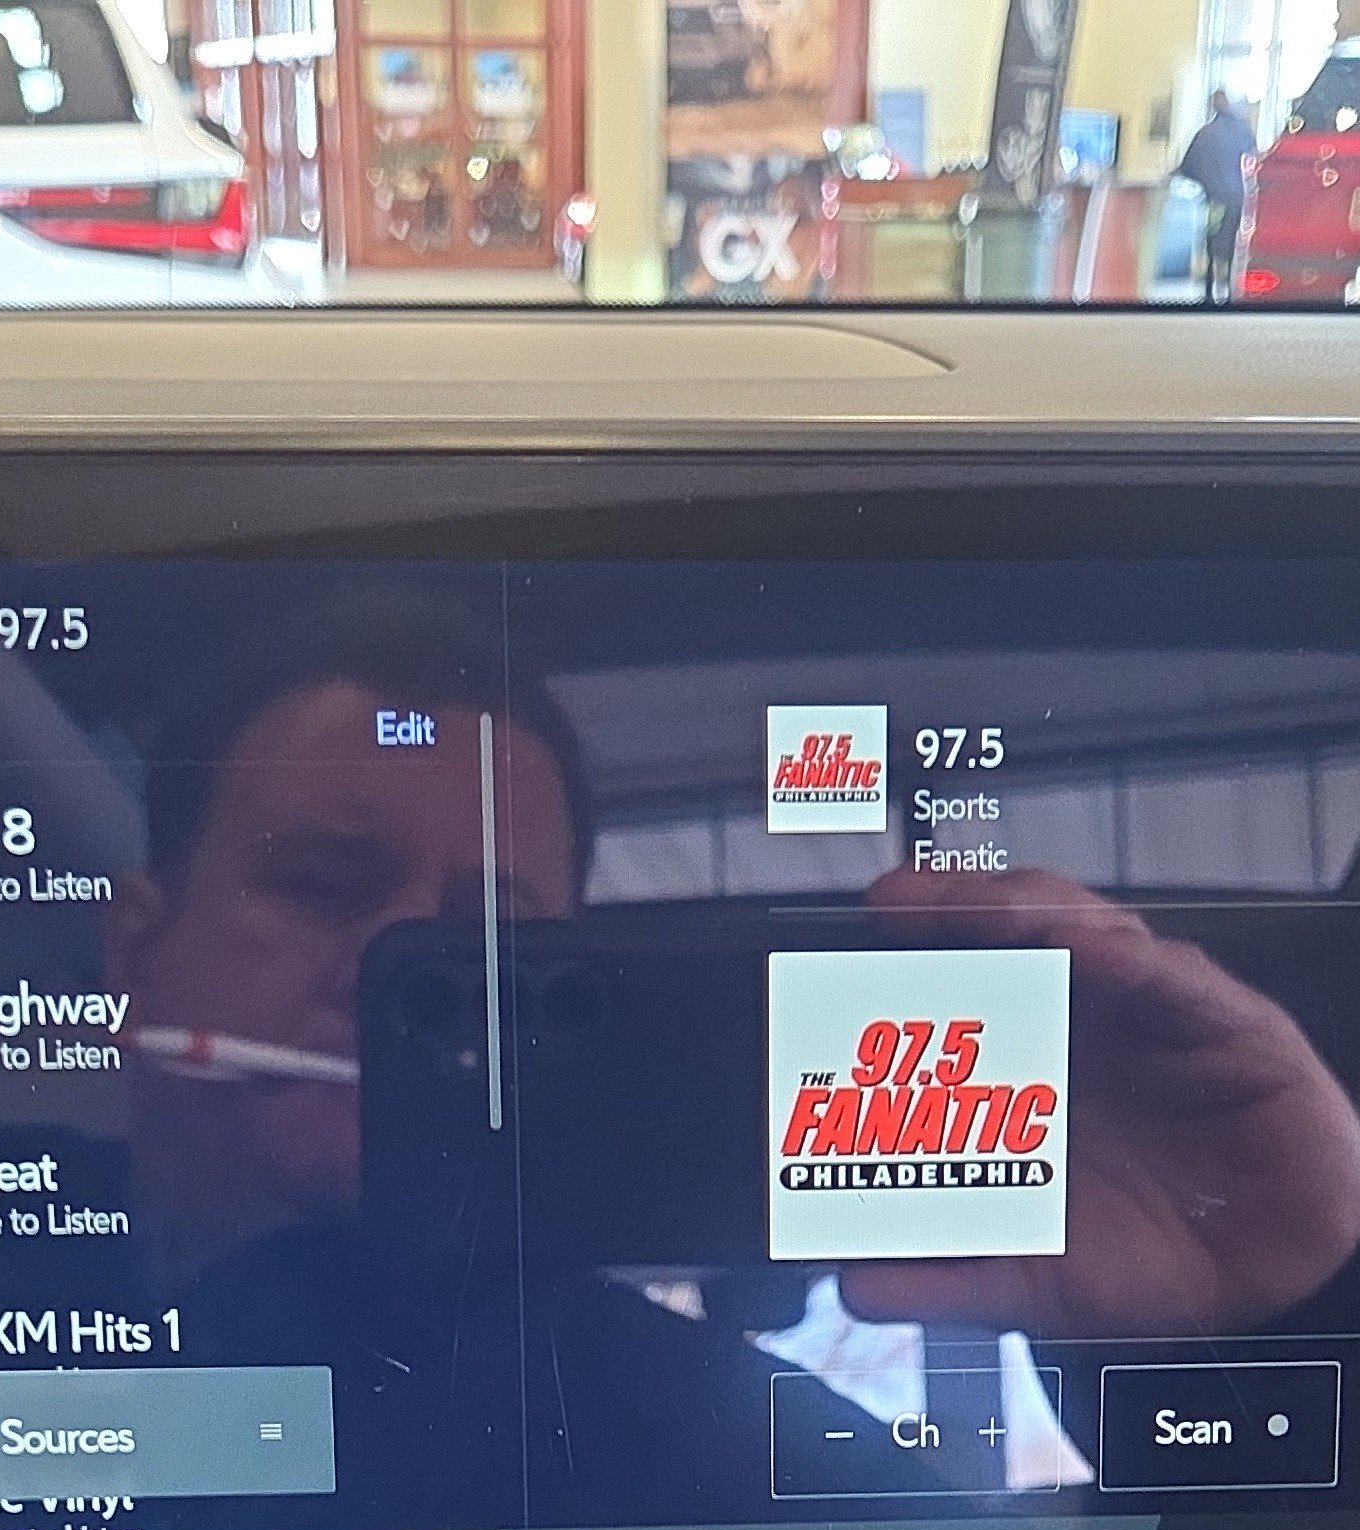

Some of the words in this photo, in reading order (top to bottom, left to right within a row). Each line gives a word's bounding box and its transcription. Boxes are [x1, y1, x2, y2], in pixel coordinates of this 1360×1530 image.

[699, 213, 801, 283] GX
[375, 711, 436, 746] Edit
[914, 727, 1004, 770] 97.5
[774, 760, 881, 788] FANATIC
[776, 792, 877, 802] PHILADELPHIA
[913, 790, 1001, 826] Sports
[1, 808, 35, 855] 8
[913, 840, 1008, 873] Fanatic
[29, 869, 112, 902] Listen
[1, 1042, 31, 1071] to
[37, 1040, 121, 1071] Listen
[851, 1018, 984, 1088] 97.5
[800, 1071, 837, 1088] THE
[781, 1083, 1058, 1157] FANATIC
[789, 1162, 1046, 1188] PHILADELPHIA
[10, 1211, 38, 1236] to
[47, 1205, 129, 1236] Listen
[71, 1309, 150, 1354] Hits
[162, 1308, 180, 1352] 1
[0, 1419, 135, 1455] Sources
[891, 1412, 940, 1449] Ch
[1154, 1409, 1232, 1446] Scan
